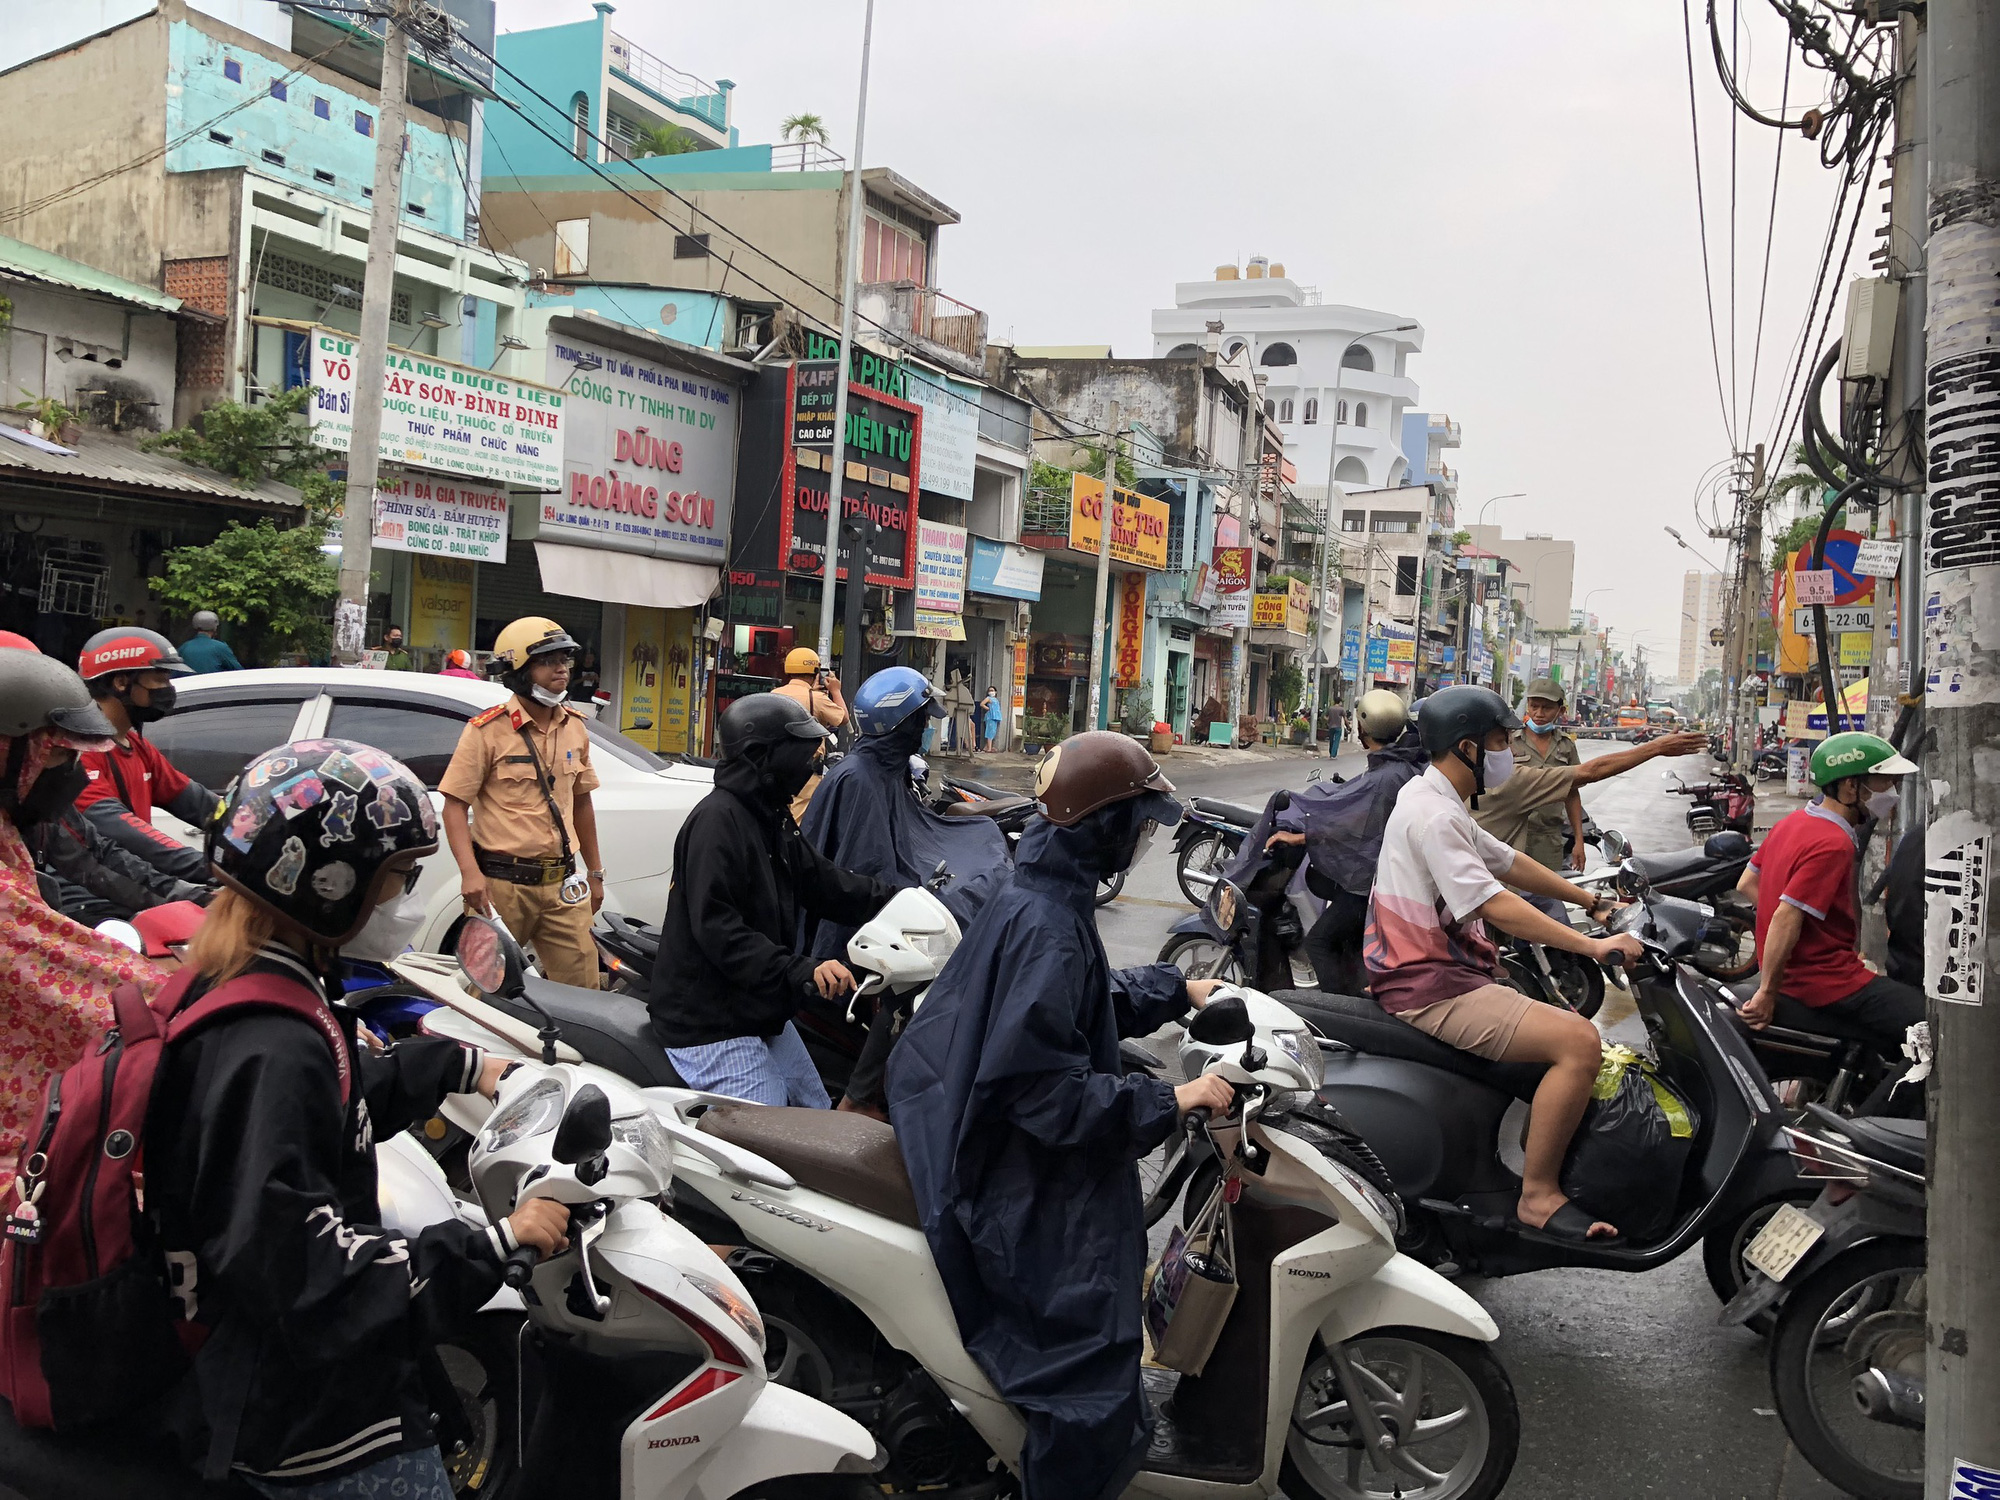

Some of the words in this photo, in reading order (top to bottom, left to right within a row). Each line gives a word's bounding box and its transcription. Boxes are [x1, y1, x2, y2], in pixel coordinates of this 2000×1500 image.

[320, 337, 359, 358] CỬ
[452, 370, 509, 396] DƯỢC
[517, 387, 562, 408] LIỆU
[323, 358, 351, 381] VÕ
[383, 372, 415, 396] ÂY
[515, 405, 558, 429] ĐỊNH
[664, 376, 679, 391] PHA
[318, 387, 337, 412] Bán
[571, 376, 612, 405] CÔNG
[617, 390, 635, 409] TY
[640, 395, 674, 420] TNHH
[678, 406, 696, 426] TM
[700, 412, 716, 431] DV
[802, 392, 819, 406] BẾP
[456, 414, 496, 432] THUỐC
[799, 428, 814, 439] CAO
[816, 426, 833, 439] CẤP
[407, 420, 435, 438] THỰC
[443, 426, 472, 444] PHẨM
[481, 436, 508, 451] CHỨC
[887, 420, 913, 462] TỪ
[332, 436, 348, 447] 079
[447, 459, 465, 470] LONG
[614, 426, 684, 475] DŨNG
[415, 478, 432, 501] ĐẢ
[436, 486, 456, 505] GIA
[569, 470, 660, 519] HOÀNG
[664, 490, 715, 529] SƠN
[799, 486, 831, 520] QUẠ
[882, 501, 908, 532] ĐÈN
[1080, 492, 1125, 526] CÔG
[408, 520, 430, 534] BONG
[792, 554, 818, 568] 950
[729, 571, 756, 586] 950
[1809, 585, 1825, 596] 9.5
[421, 594, 465, 614] valspar
[1258, 600, 1282, 611] CÔNG
[1256, 612, 1274, 622] THỌ
[94, 646, 147, 665] LOSHIP
[1825, 747, 1866, 768] Grab
[1287, 1268, 1332, 1280] HONDA
[647, 1434, 701, 1450] HONDA
